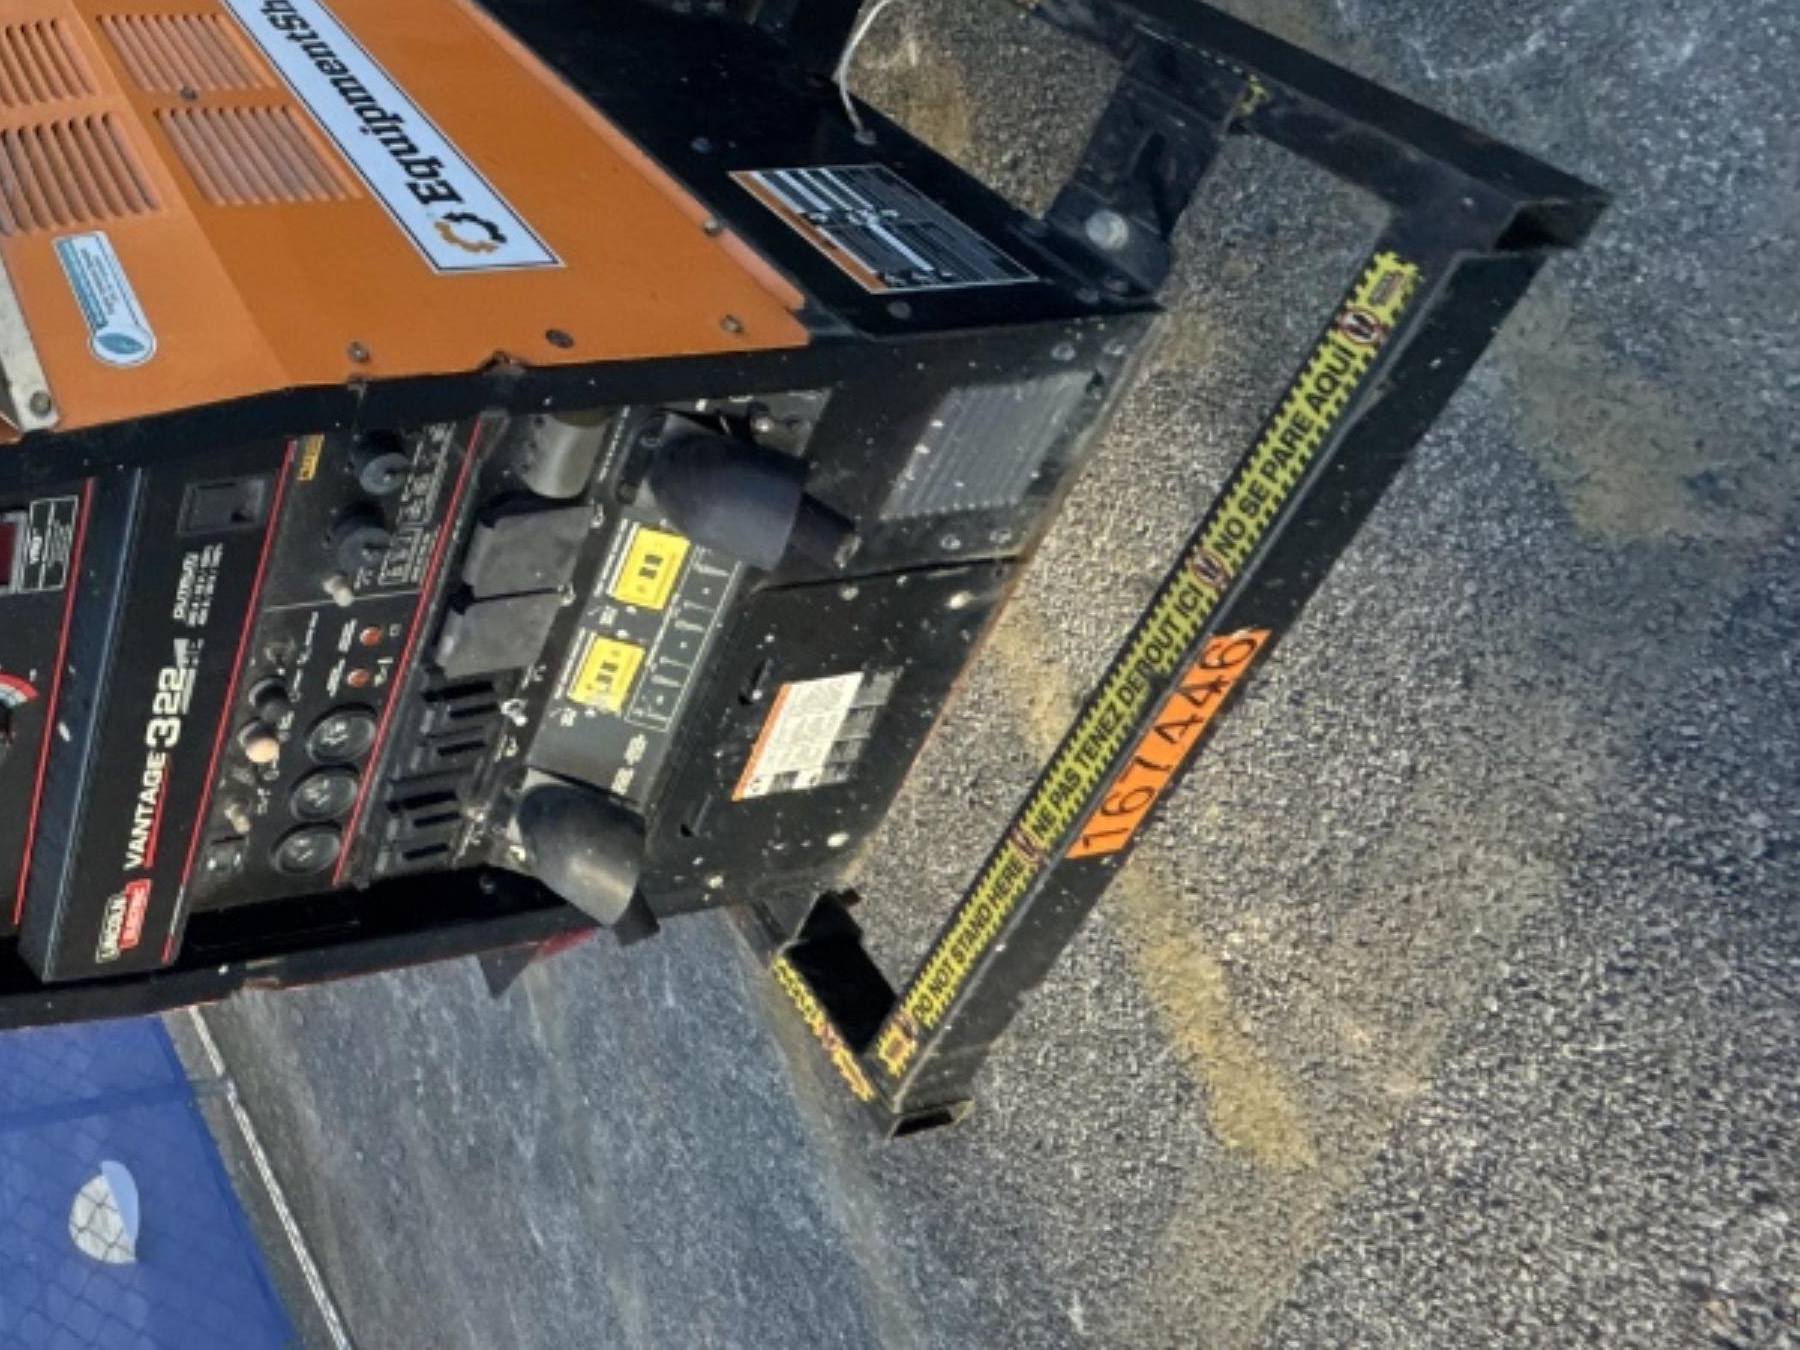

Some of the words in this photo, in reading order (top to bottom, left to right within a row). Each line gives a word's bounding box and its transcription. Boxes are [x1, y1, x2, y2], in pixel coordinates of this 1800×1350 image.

[1210, 516, 1247, 559] NO
[1239, 480, 1270, 518] SE
[1259, 410, 1312, 483] PARE
[1302, 341, 1355, 414] AQUÍ
[144, 667, 182, 749] 322
[1028, 804, 1054, 840] NE
[1047, 770, 1083, 811] PAS
[1075, 701, 1124, 769] TENEZ
[1173, 580, 1205, 617] ICI
[122, 751, 167, 871] VANTAGE
[925, 957, 954, 997] NOT
[947, 903, 993, 964] STAND
[988, 858, 1023, 910] HERE
